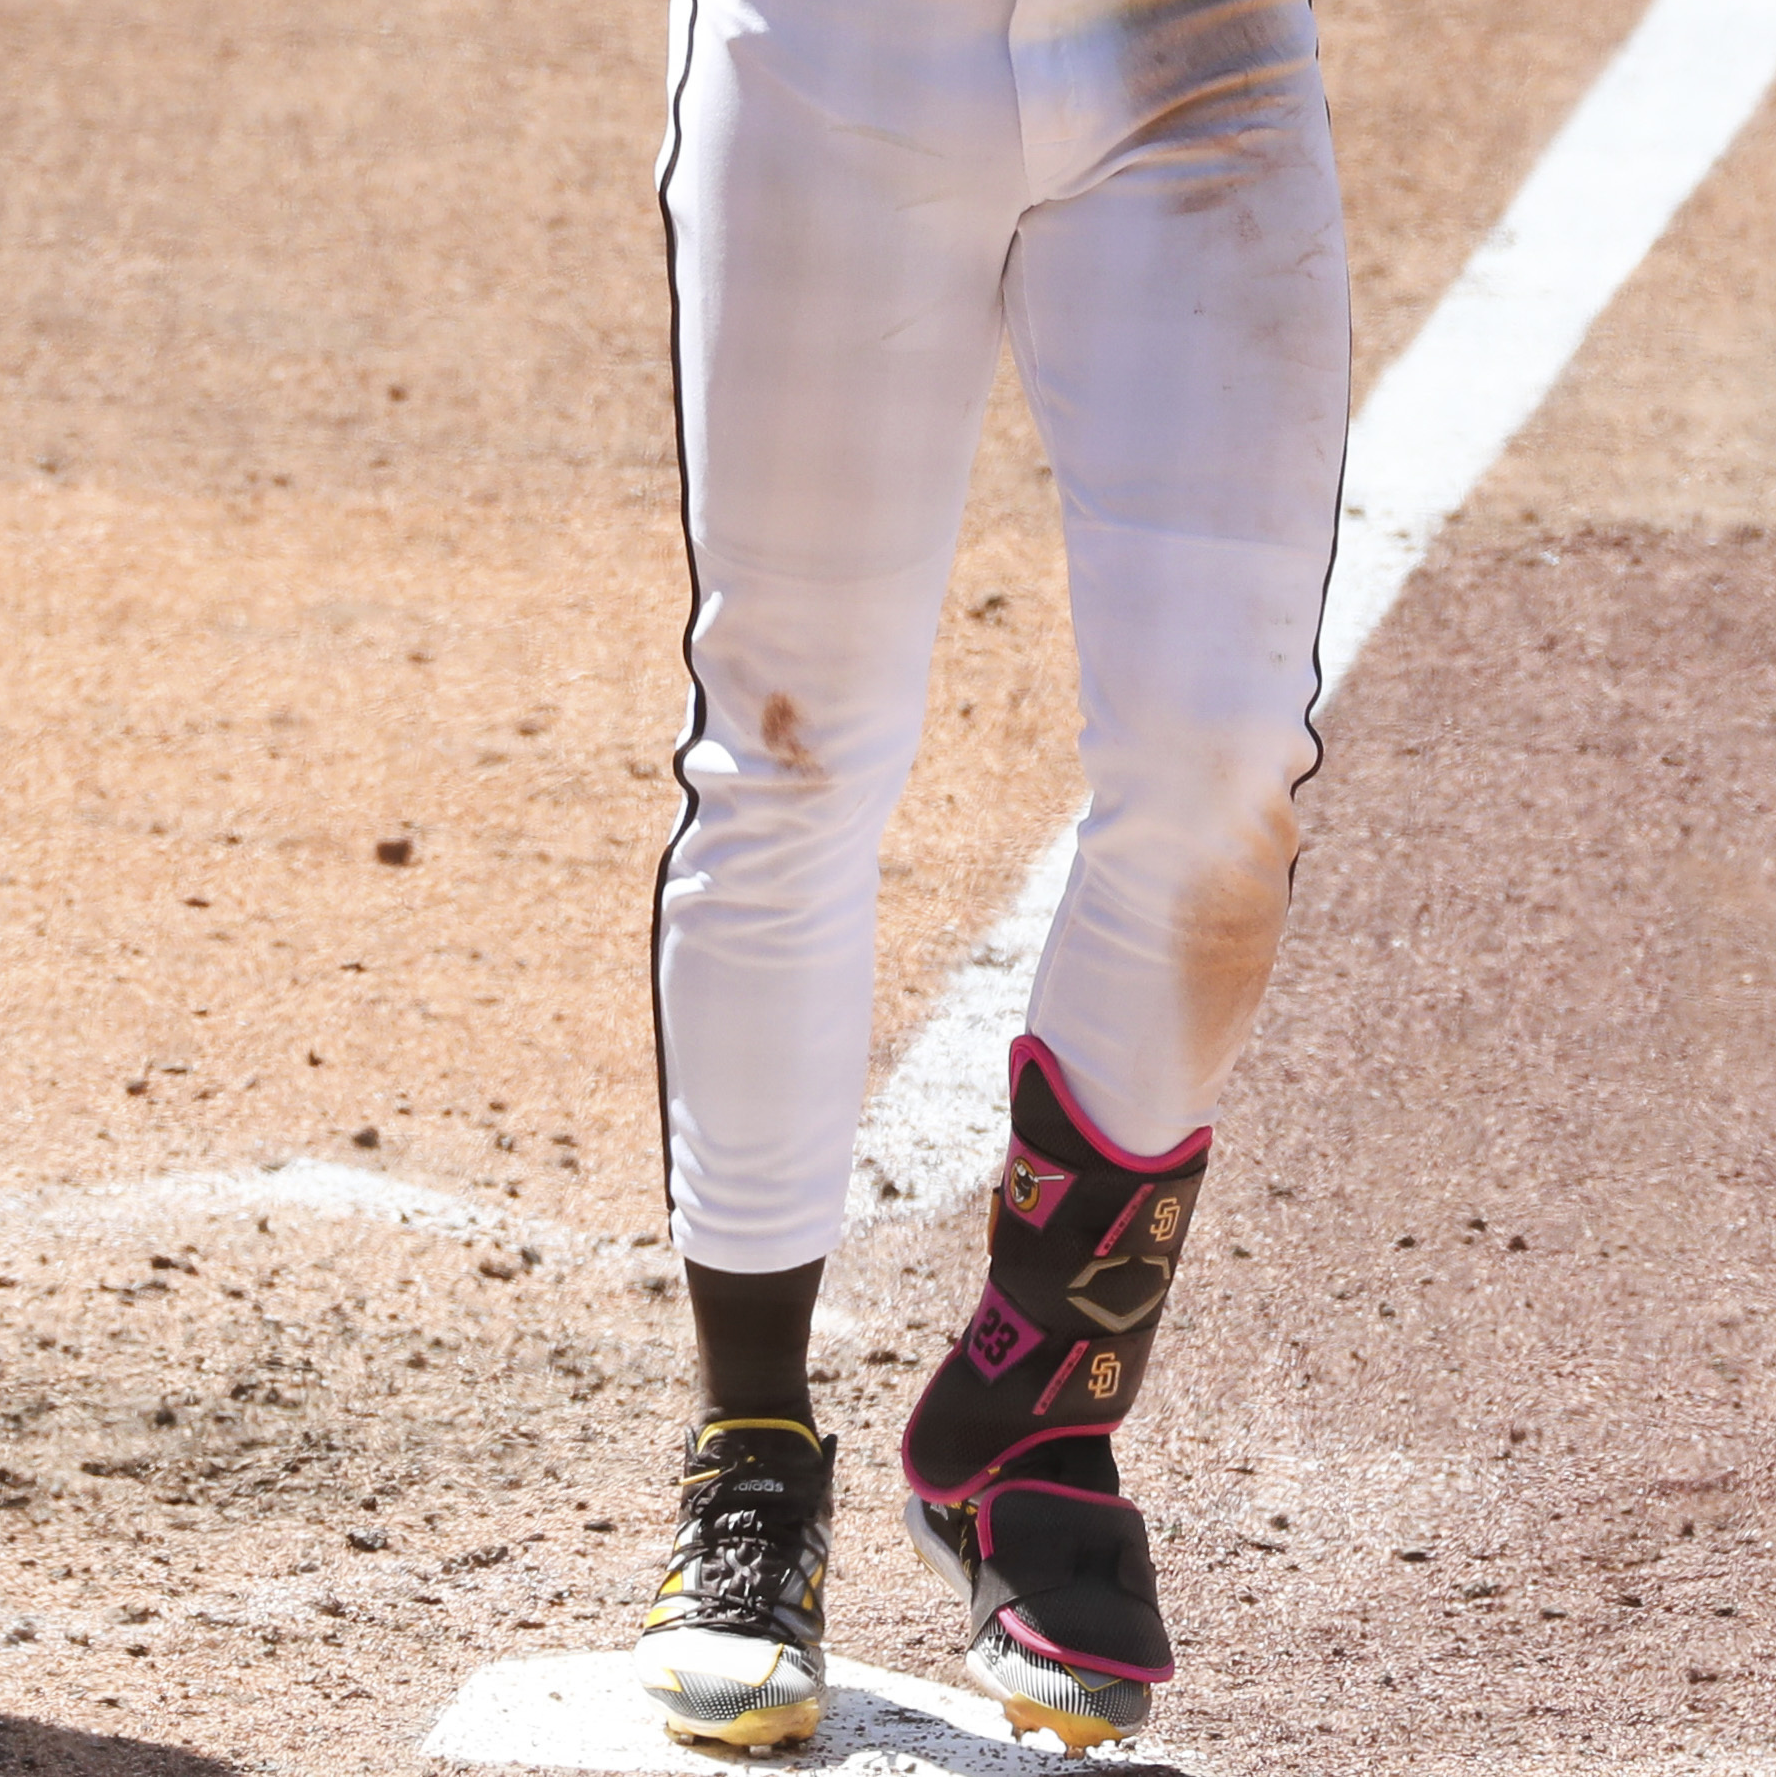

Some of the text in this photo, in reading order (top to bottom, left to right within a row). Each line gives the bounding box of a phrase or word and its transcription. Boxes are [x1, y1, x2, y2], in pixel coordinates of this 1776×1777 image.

[1149, 1196, 1182, 1242] SD
[973, 1304, 1020, 1367] 23
[1087, 1352, 1122, 1400] SD
